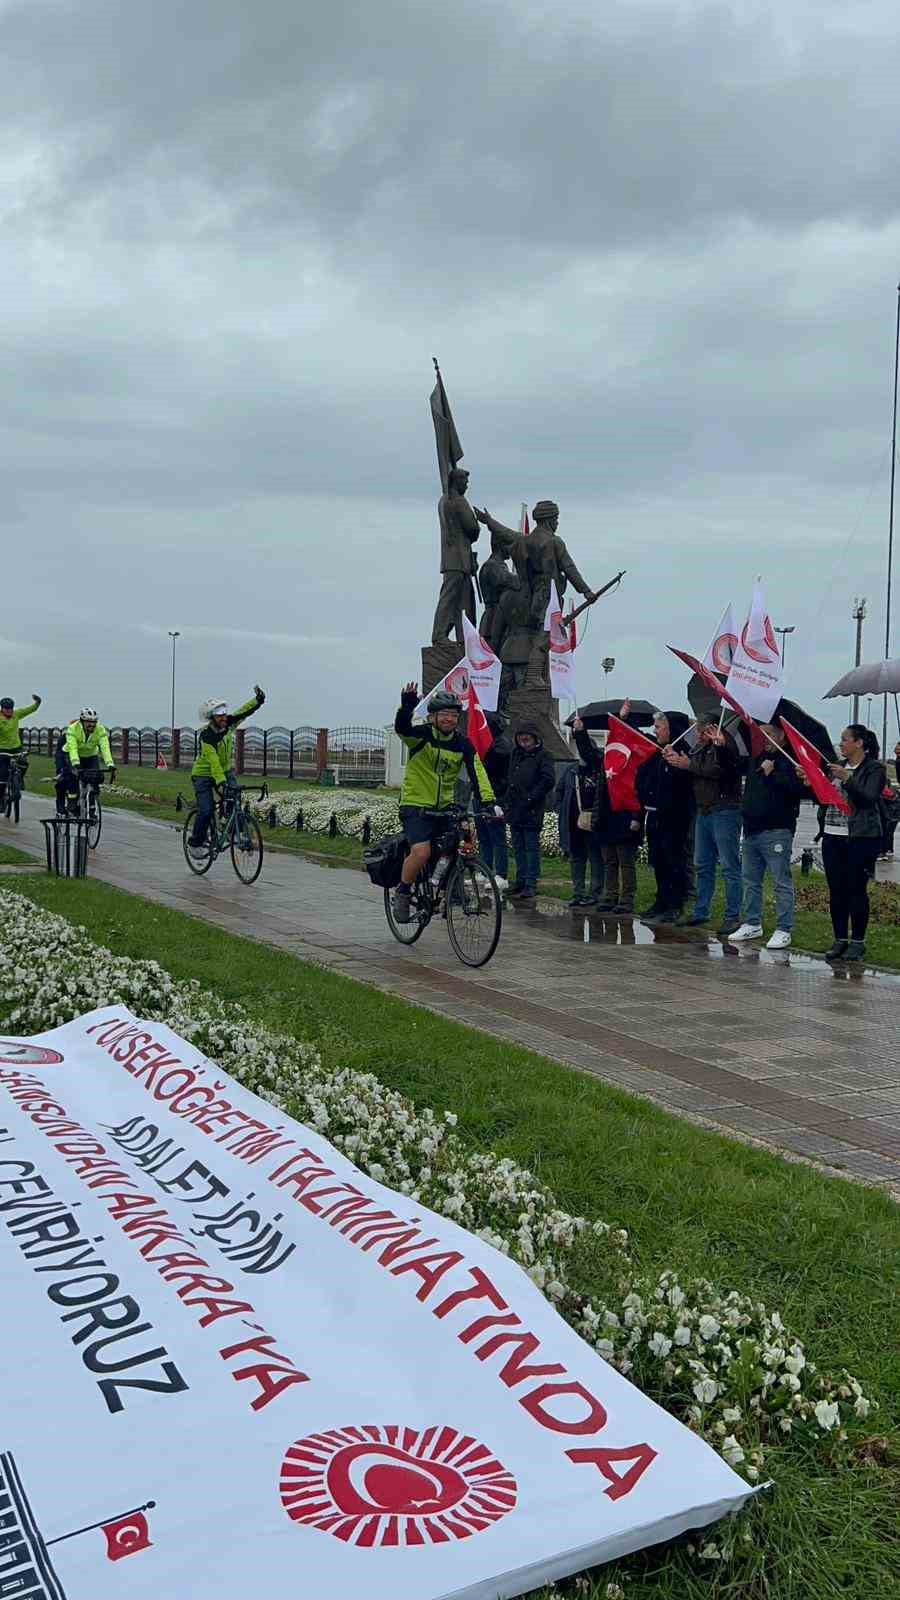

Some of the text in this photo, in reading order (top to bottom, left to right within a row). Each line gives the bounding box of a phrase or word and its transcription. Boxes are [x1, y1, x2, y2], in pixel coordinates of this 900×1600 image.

[97, 1115, 297, 1275] ADALET İÇİN
[97, 1192, 312, 1412] ANKARA'YA
[267, 1147, 659, 1502] TAZMİNATINDA
